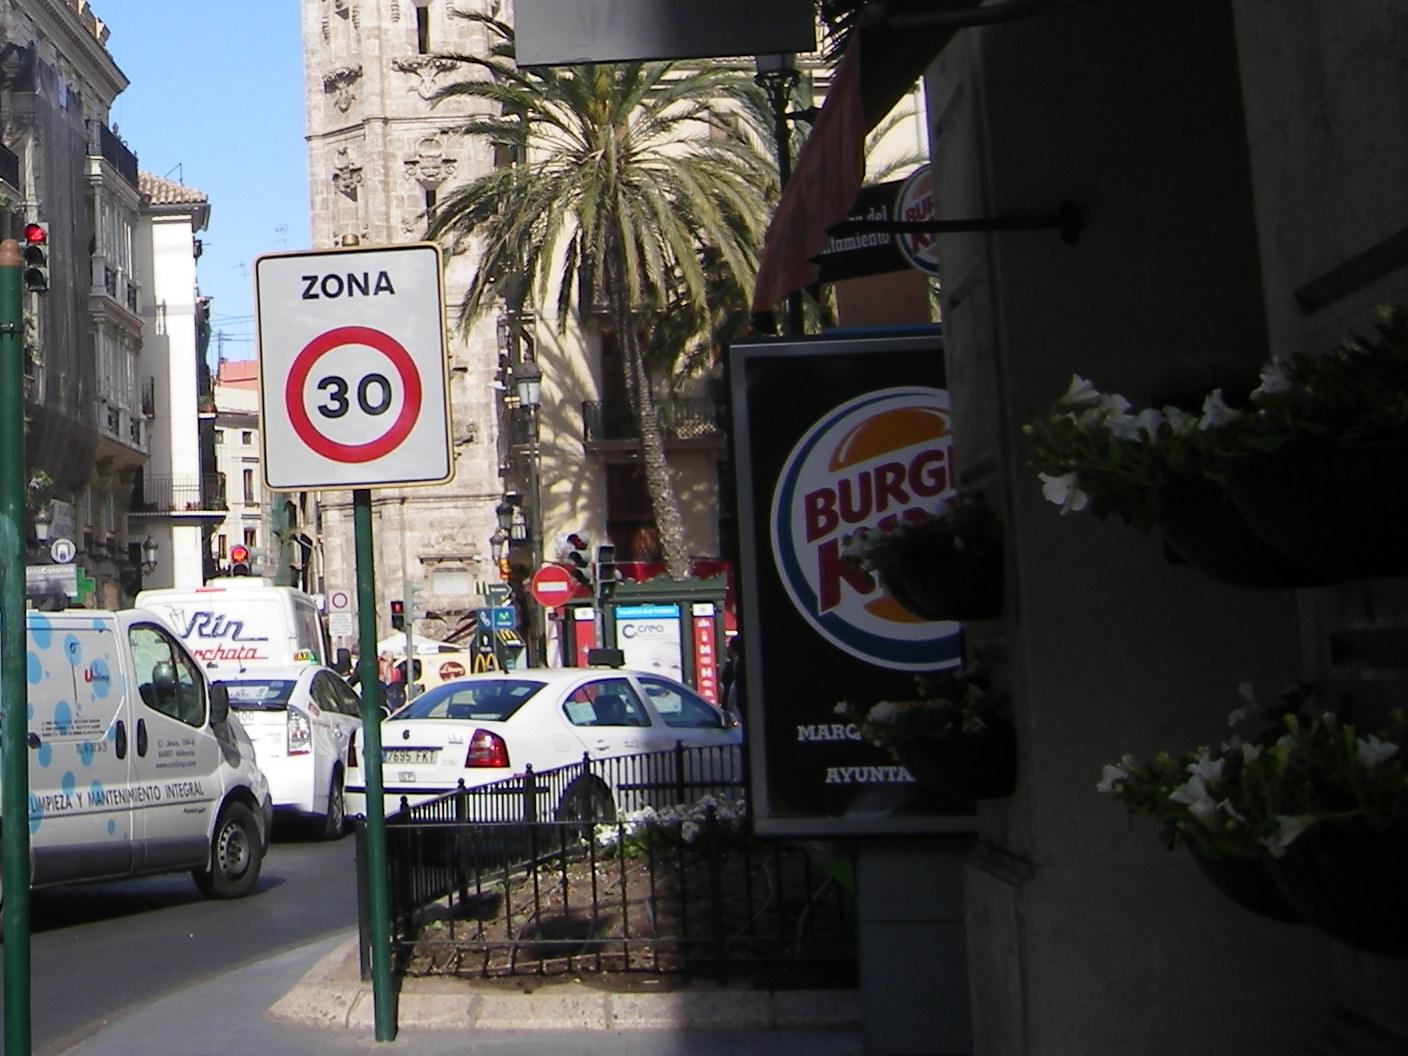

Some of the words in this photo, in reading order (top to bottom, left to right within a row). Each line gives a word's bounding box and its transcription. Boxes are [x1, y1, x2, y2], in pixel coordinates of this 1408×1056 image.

[301, 270, 396, 300] ZONA
[317, 372, 393, 419] 30
[803, 445, 955, 544] BURG
[30, 793, 73, 814] LIMPIEZA
[77, 792, 84, 806] Y
[88, 785, 161, 805] MANTENIMIENTO
[165, 781, 204, 800] INTEGRAL
